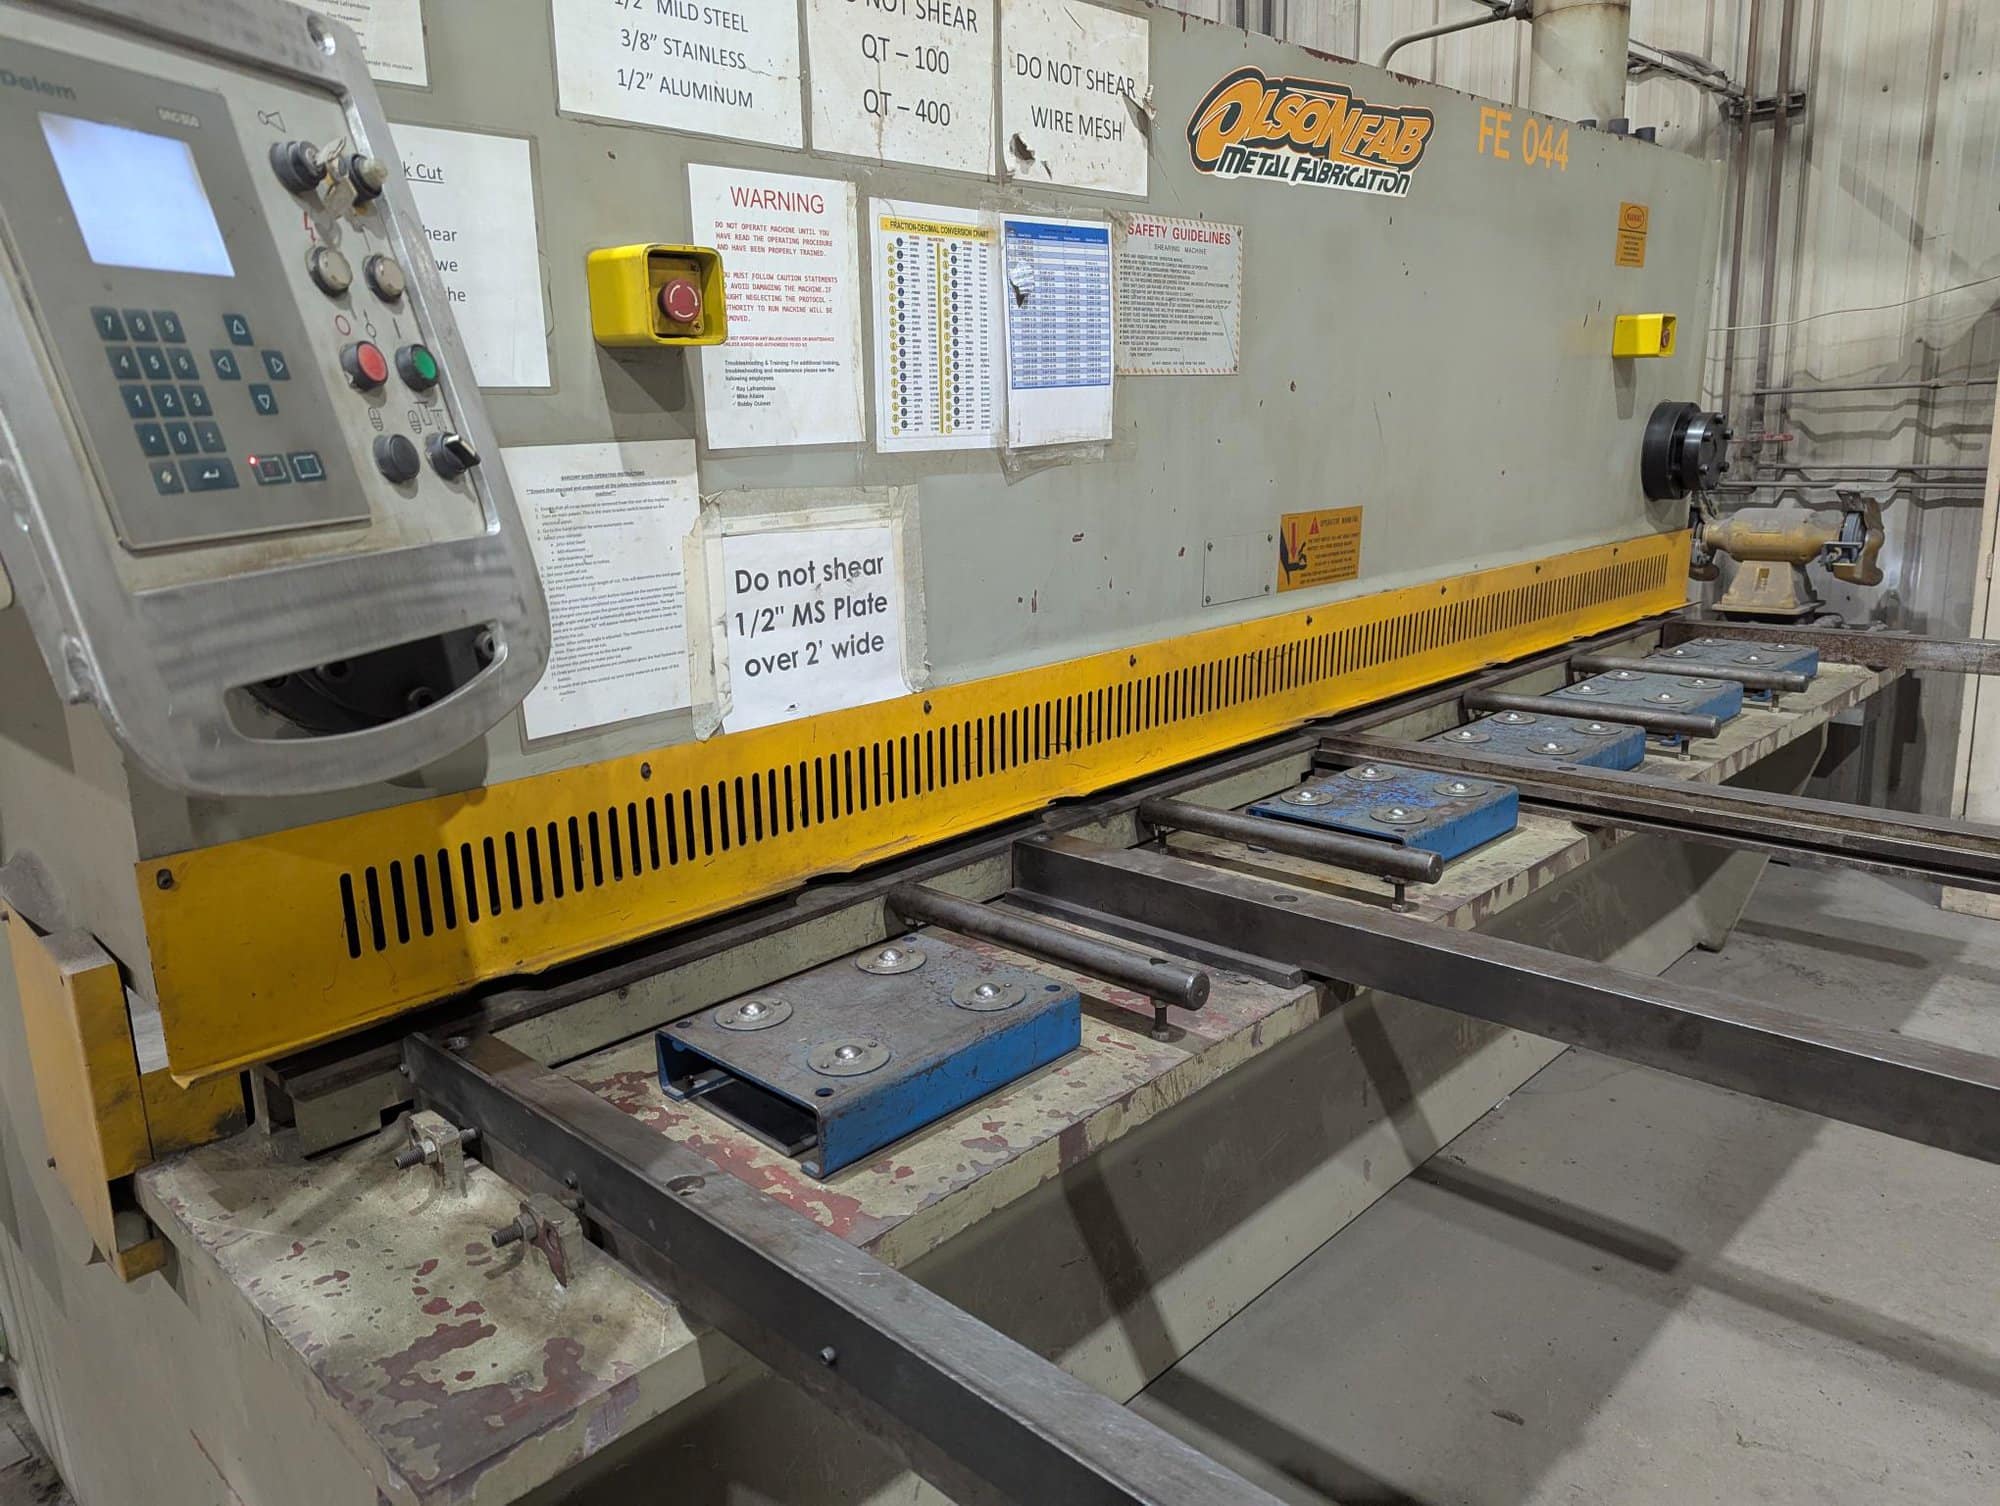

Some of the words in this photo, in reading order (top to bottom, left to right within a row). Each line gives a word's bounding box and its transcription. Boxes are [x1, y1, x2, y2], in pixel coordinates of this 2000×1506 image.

[657, 0, 698, 21] MILD
[704, 7, 749, 33] STEEL
[915, 0, 977, 33] SHEAR
[621, 28, 657, 51] 3/8"
[663, 37, 746, 69] STAINLESS
[862, 34, 890, 63] QT
[915, 46, 949, 75] 100
[1016, 53, 1041, 79] DO
[1047, 60, 1081, 87] NOT
[1086, 69, 1136, 98] SHEAR
[617, 68, 653, 91] 1/2"
[659, 76, 753, 108] ALUMINUM
[863, 89, 892, 117] QT
[915, 98, 950, 126] 400
[1031, 105, 1073, 133] WIRE
[1079, 114, 1122, 142] MESH
[1478, 106, 1512, 160] FE
[1523, 118, 1568, 171] 044
[1216, 146, 1290, 176] METAL
[417, 164, 444, 181] Cut
[730, 186, 824, 214] WARNING
[423, 225, 457, 242] hear
[716, 232, 731, 240] HAVE
[735, 233, 750, 241] READ
[754, 234, 764, 242] THE
[767, 236, 800, 245] OPERATING
[802, 238, 833, 247] PROCEDURE
[727, 222, 738, 230] NOT
[741, 223, 767, 232] OPERATE
[770, 224, 795, 234] MACHINE
[799, 226, 816, 236] UNTIL
[819, 229, 830, 237] YOU
[940, 226, 972, 237] CONVERSION
[973, 229, 989, 238] CHART
[1128, 223, 1168, 239] SAFETY
[1172, 227, 1231, 245] GUIDELINES
[731, 244, 747, 252] HAVE
[750, 245, 765, 254] BEEN
[768, 246, 796, 255] PROPERLY
[1154, 244, 1180, 252] SHEARING
[1184, 246, 1207, 256] MACHINE
[751, 273, 774, 281] FOLLOW
[776, 273, 802, 281] CAUTION
[804, 275, 838, 284] STATEMENTS
[752, 284, 782, 292] DAMAGING
[448, 287, 466, 301] he
[104, 317, 113, 329] 7
[165, 319, 174, 332] 9
[121, 357, 129, 369] 4
[150, 357, 160, 370] 5
[180, 357, 188, 370] 6
[135, 395, 142, 407] 1
[164, 394, 174, 407] 2
[193, 394, 202, 407] 3
[178, 432, 187, 445] 0
[735, 569, 769, 594] Do
[778, 560, 815, 588] not
[823, 557, 884, 582] shear
[735, 606, 784, 639] 1/2"
[792, 600, 825, 627] MS
[834, 592, 887, 620] Plate
[745, 650, 798, 677] over
[805, 640, 822, 666] 2'
[831, 632, 884, 659] wide
